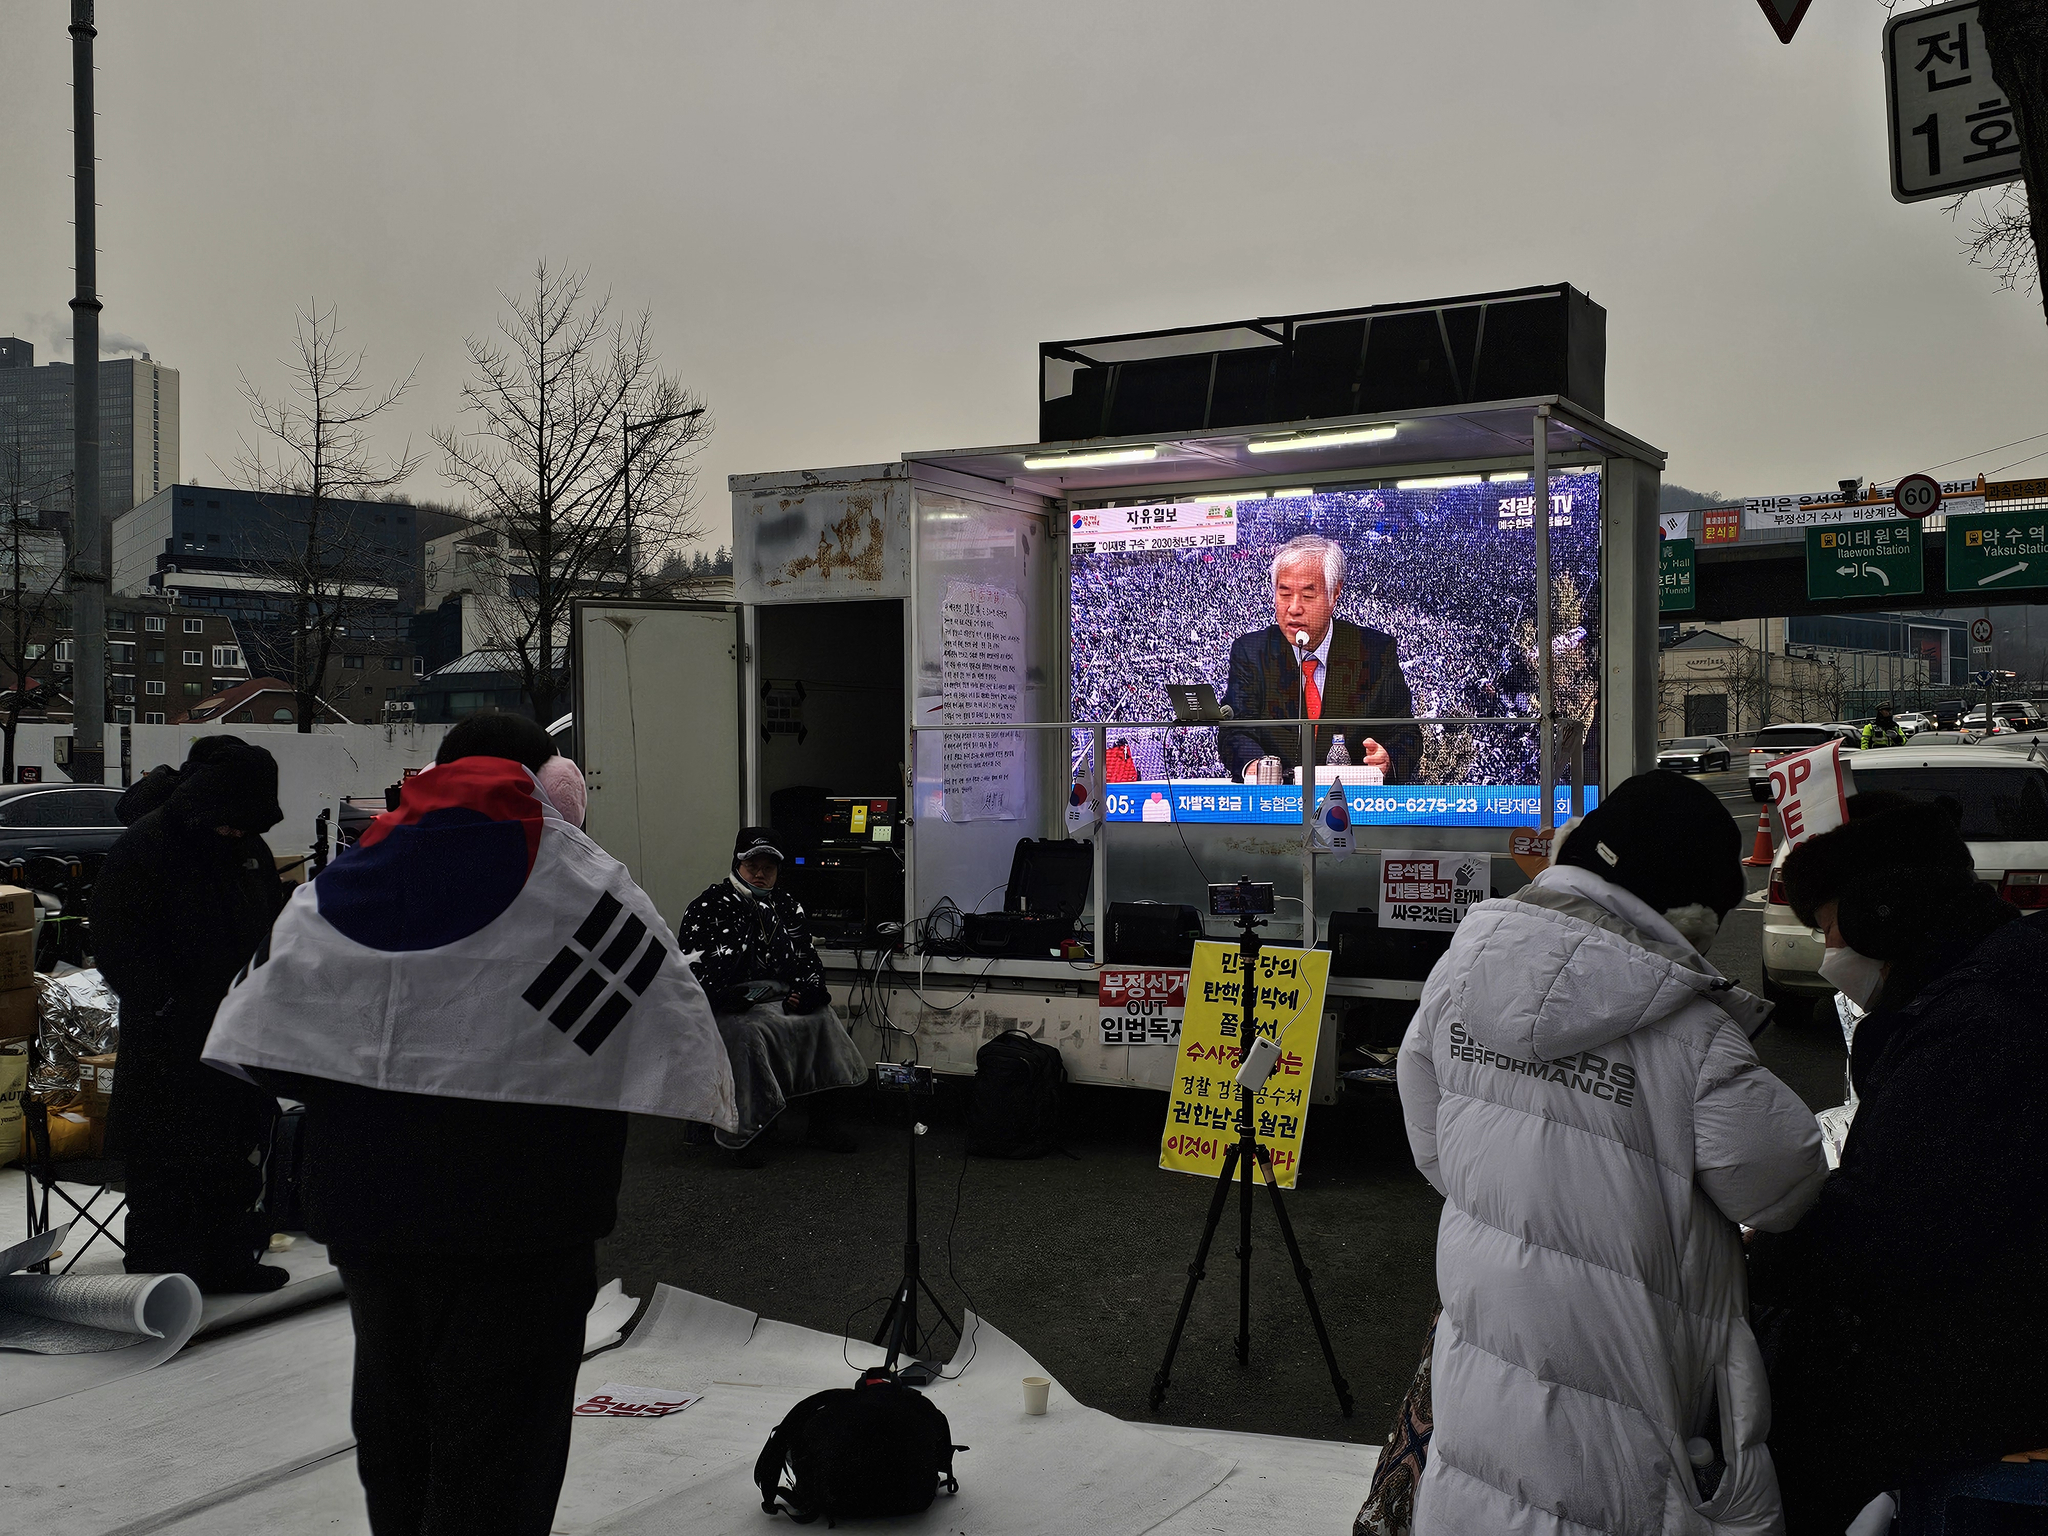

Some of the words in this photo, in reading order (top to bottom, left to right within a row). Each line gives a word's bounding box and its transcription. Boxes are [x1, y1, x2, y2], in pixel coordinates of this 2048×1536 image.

[1498, 495, 1573, 517] 전광TV
[1745, 498, 1793, 514] 국민은
[1904, 486, 1931, 506] 60
[1126, 508, 1178, 525] 자유일보
[1498, 517, 1533, 530] 예수한국
[1774, 513, 1816, 526] 부정선거
[1821, 511, 1843, 522] 수사
[1853, 507, 1897, 521] 비상계엄
[1200, 534, 1226, 546] 거리로
[1837, 526, 1909, 547] 이태원역
[1983, 525, 2045, 545] 약수역
[1837, 548, 1875, 559] Itaewon
[1876, 543, 1910, 556] Station
[1983, 545, 2017, 557] Yaksu
[1672, 558, 1690, 568] Hall
[1178, 795, 1215, 811] 자발적
[1217, 795, 1242, 811] 헌금
[1484, 798, 1570, 815] 사랑제일회
[1387, 863, 1435, 880] 윤석열
[1387, 882, 1451, 900] 대통령과
[1452, 888, 1484, 904] 함께
[1390, 904, 1470, 924] 싸우겠습니
[1102, 973, 1189, 998] 부정선거
[1126, 1000, 1167, 1016] OUT
[1450, 1043, 1635, 1109] PERFORMANCE
[1181, 1075, 1212, 1098] 경찰
[1258, 1110, 1299, 1140] 월권
[1167, 1134, 1218, 1160] 이것이
